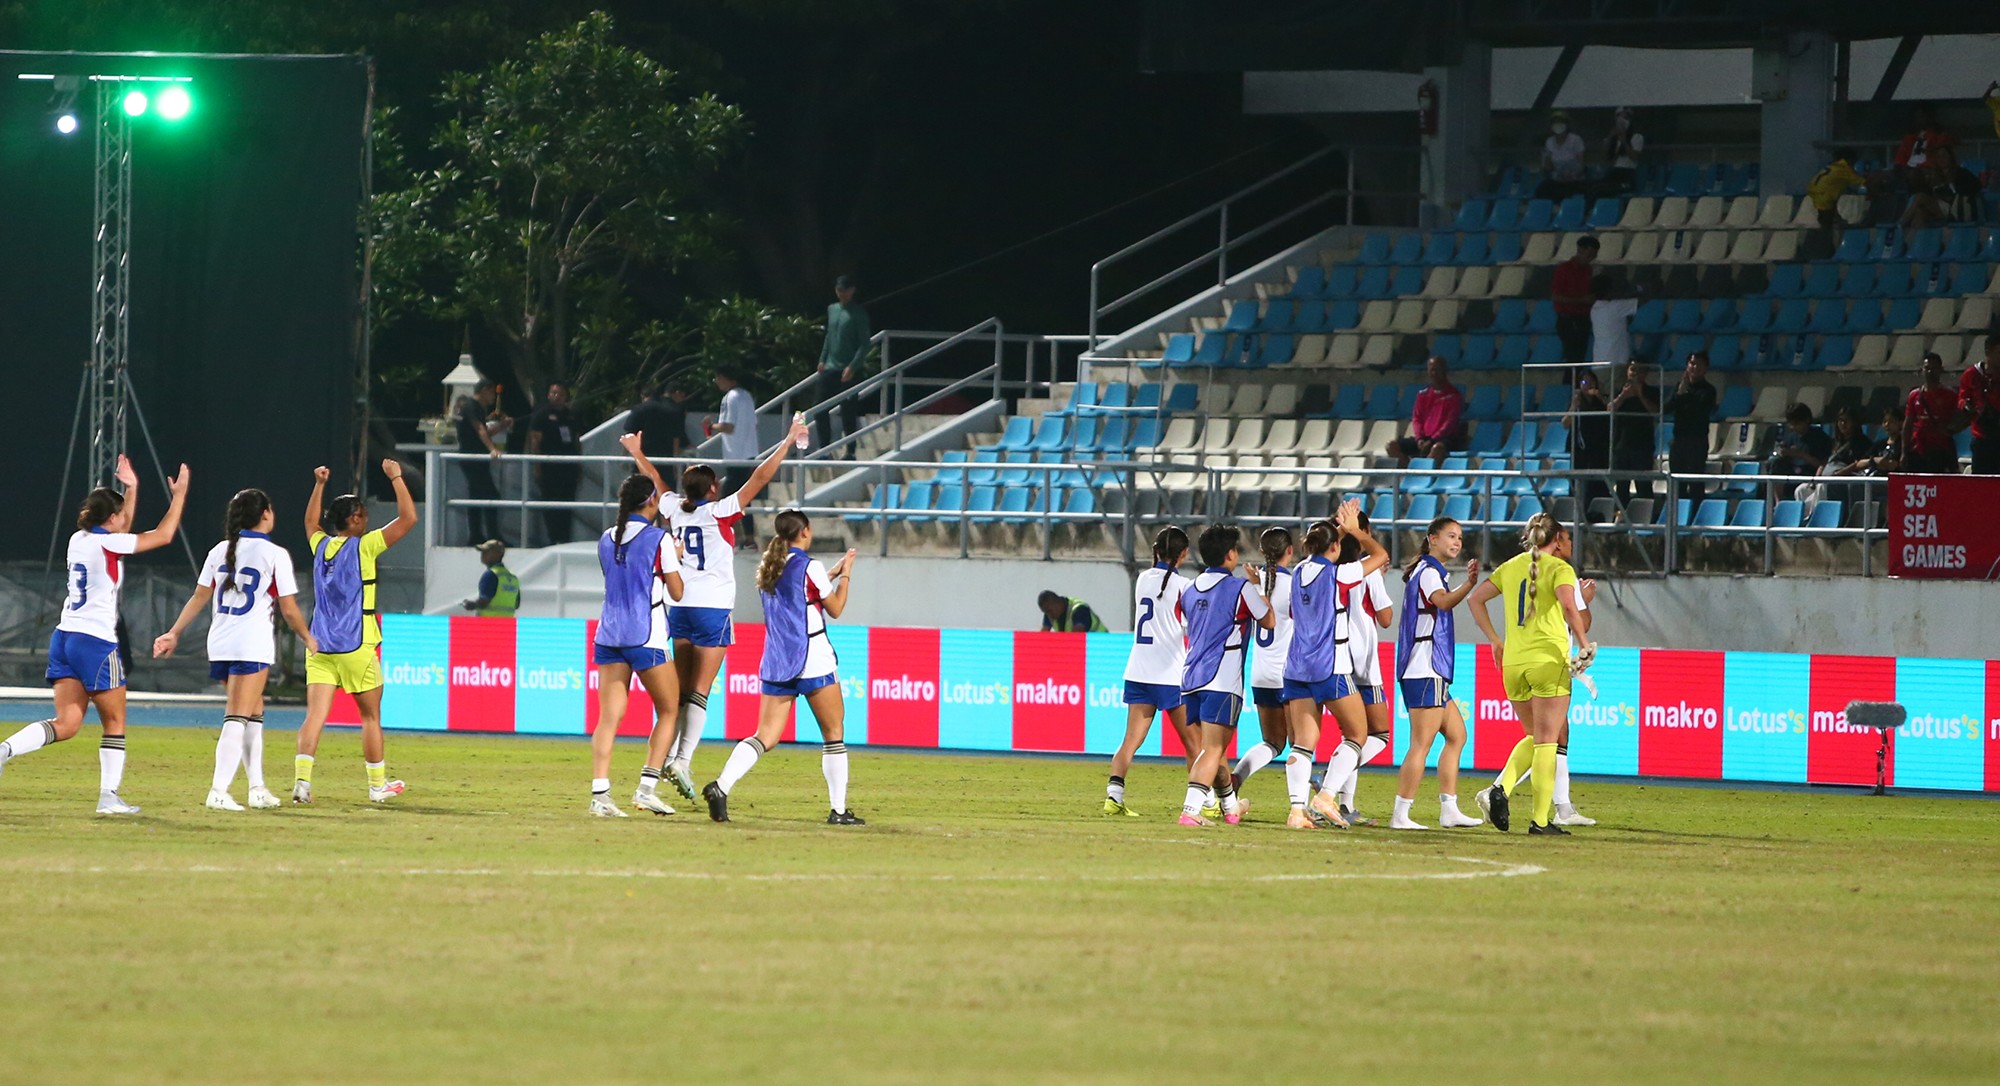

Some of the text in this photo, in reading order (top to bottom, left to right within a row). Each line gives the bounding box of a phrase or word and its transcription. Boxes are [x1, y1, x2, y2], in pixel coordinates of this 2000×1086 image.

[1904, 484, 1936, 508] 33rd
[1903, 514, 1938, 538] SEA
[1902, 544, 1967, 569] GAMES
[1136, 597, 1154, 645] 2
[384, 661, 445, 685] Lotus's
[453, 661, 511, 687] makro
[519, 665, 581, 689] Lotus's
[872, 674, 934, 701] makro
[943, 679, 1009, 704] Lotus's
[1016, 677, 1081, 705] makro
[1567, 701, 1636, 726] otus's
[1645, 700, 1718, 730] makro
[1727, 706, 1806, 734] Lotus's
